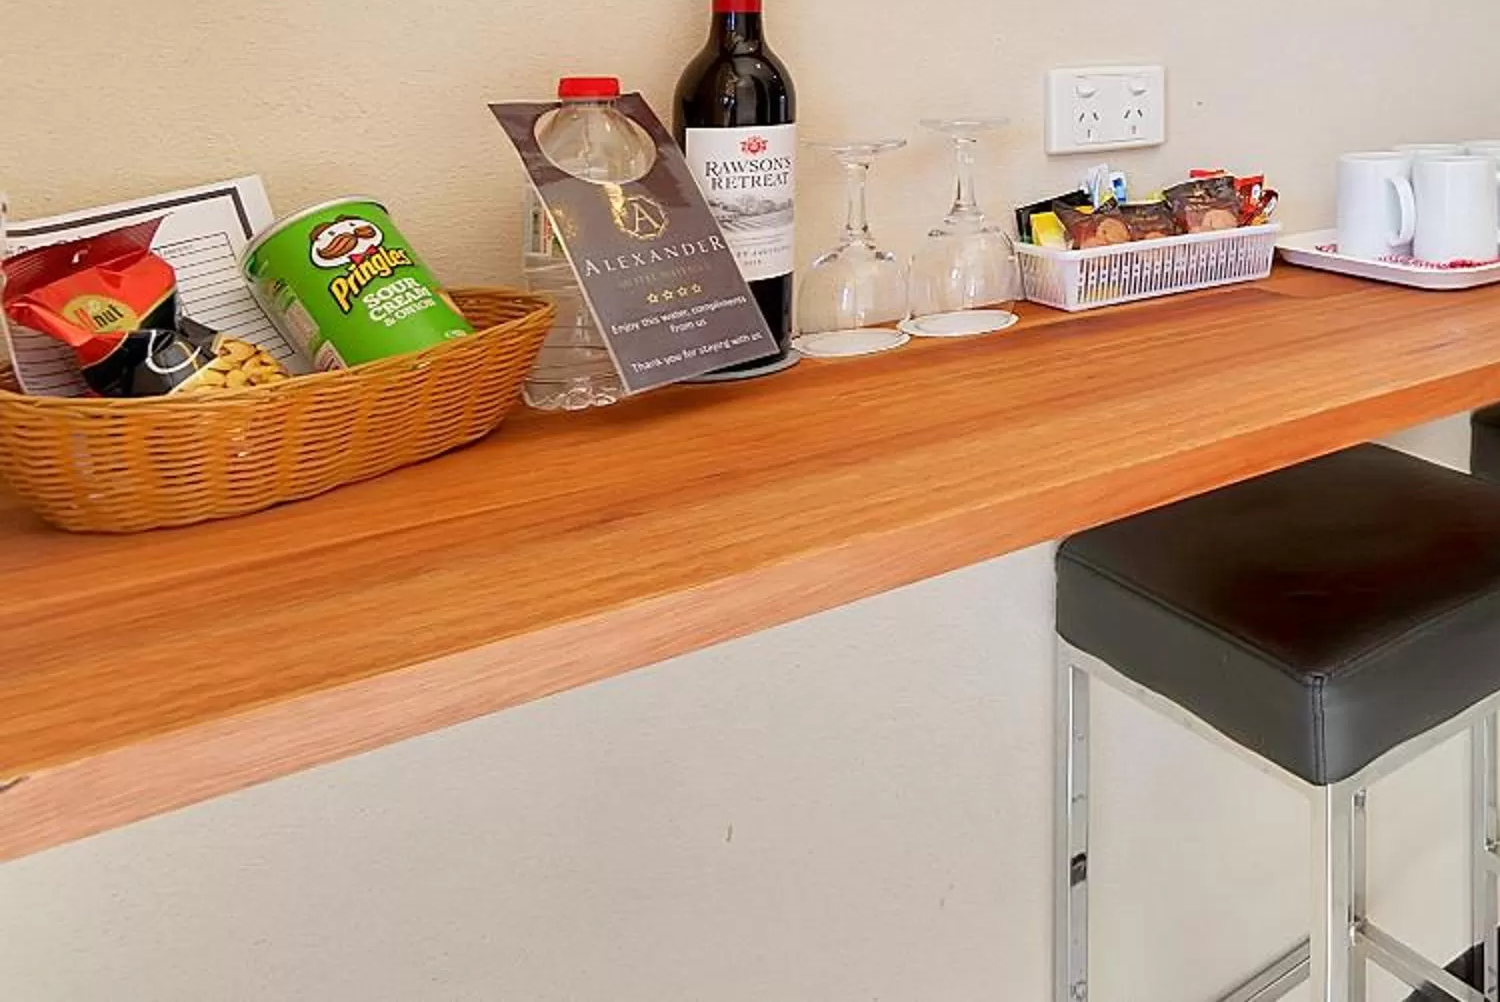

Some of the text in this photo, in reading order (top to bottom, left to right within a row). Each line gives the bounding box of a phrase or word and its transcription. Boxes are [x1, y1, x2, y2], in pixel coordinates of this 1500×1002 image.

[711, 172, 788, 191] RETREAT
[584, 235, 726, 277] ALEXANDER
[329, 245, 414, 314] Pringles
[363, 277, 421, 309] SOUR
[369, 286, 433, 321] CREAM
[397, 298, 436, 320] ONION
[611, 321, 640, 335] Enjoy
[670, 318, 708, 333] from us
[631, 357, 663, 374] Thank
[663, 354, 683, 366] you
[682, 348, 697, 359] for
[731, 333, 750, 346] with
